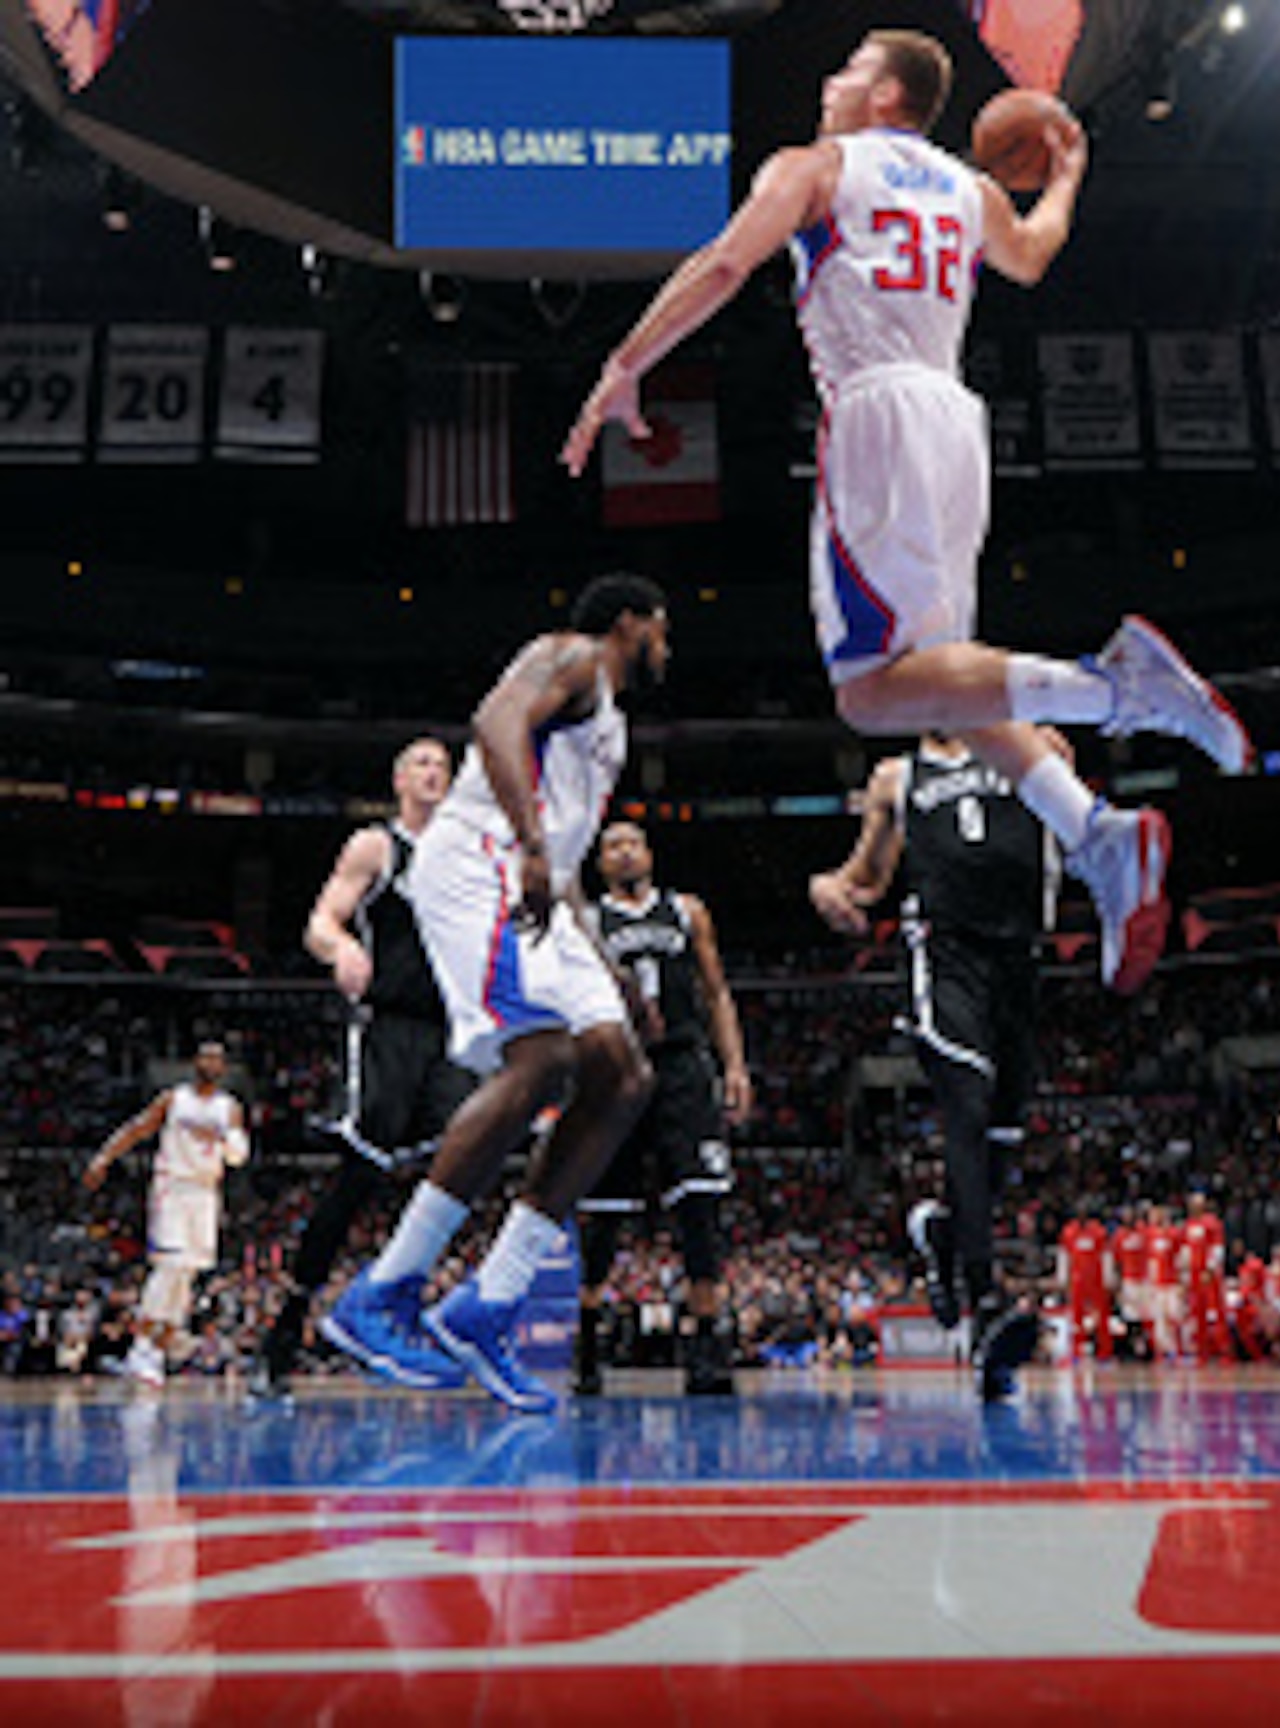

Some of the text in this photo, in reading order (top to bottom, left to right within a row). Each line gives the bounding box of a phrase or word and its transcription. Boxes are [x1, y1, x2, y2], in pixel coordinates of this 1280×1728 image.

[433, 126, 732, 166] NBA GAME TIME APP
[871, 209, 963, 301] 32
[2, 371, 75, 421] 99
[112, 373, 188, 421] 20
[251, 374, 286, 421] 4
